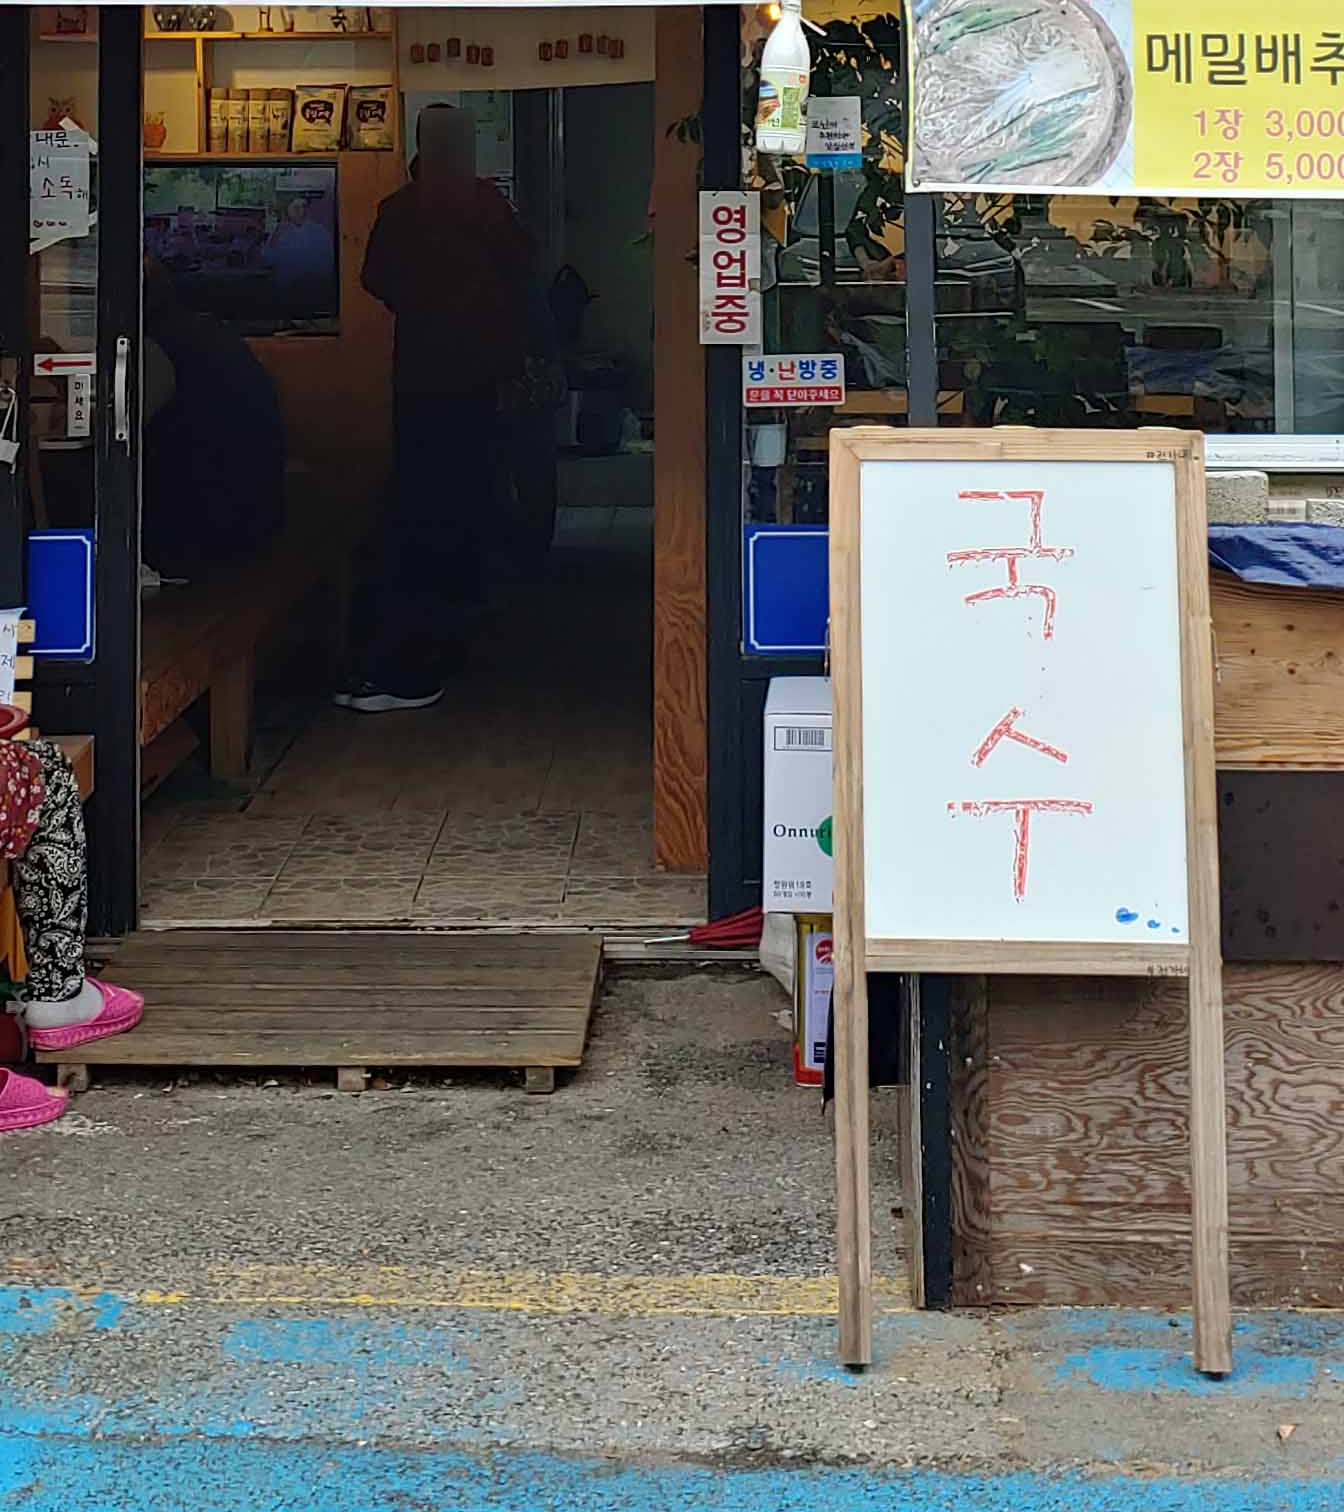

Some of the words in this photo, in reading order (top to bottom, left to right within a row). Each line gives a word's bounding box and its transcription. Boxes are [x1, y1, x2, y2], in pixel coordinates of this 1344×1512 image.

[1193, 108, 1244, 141] 1장
[1193, 151, 1244, 184] 2장
[711, 203, 750, 336] 영업중
[787, 388, 840, 401] 닫아주세요
[946, 490, 1092, 904] 국수
